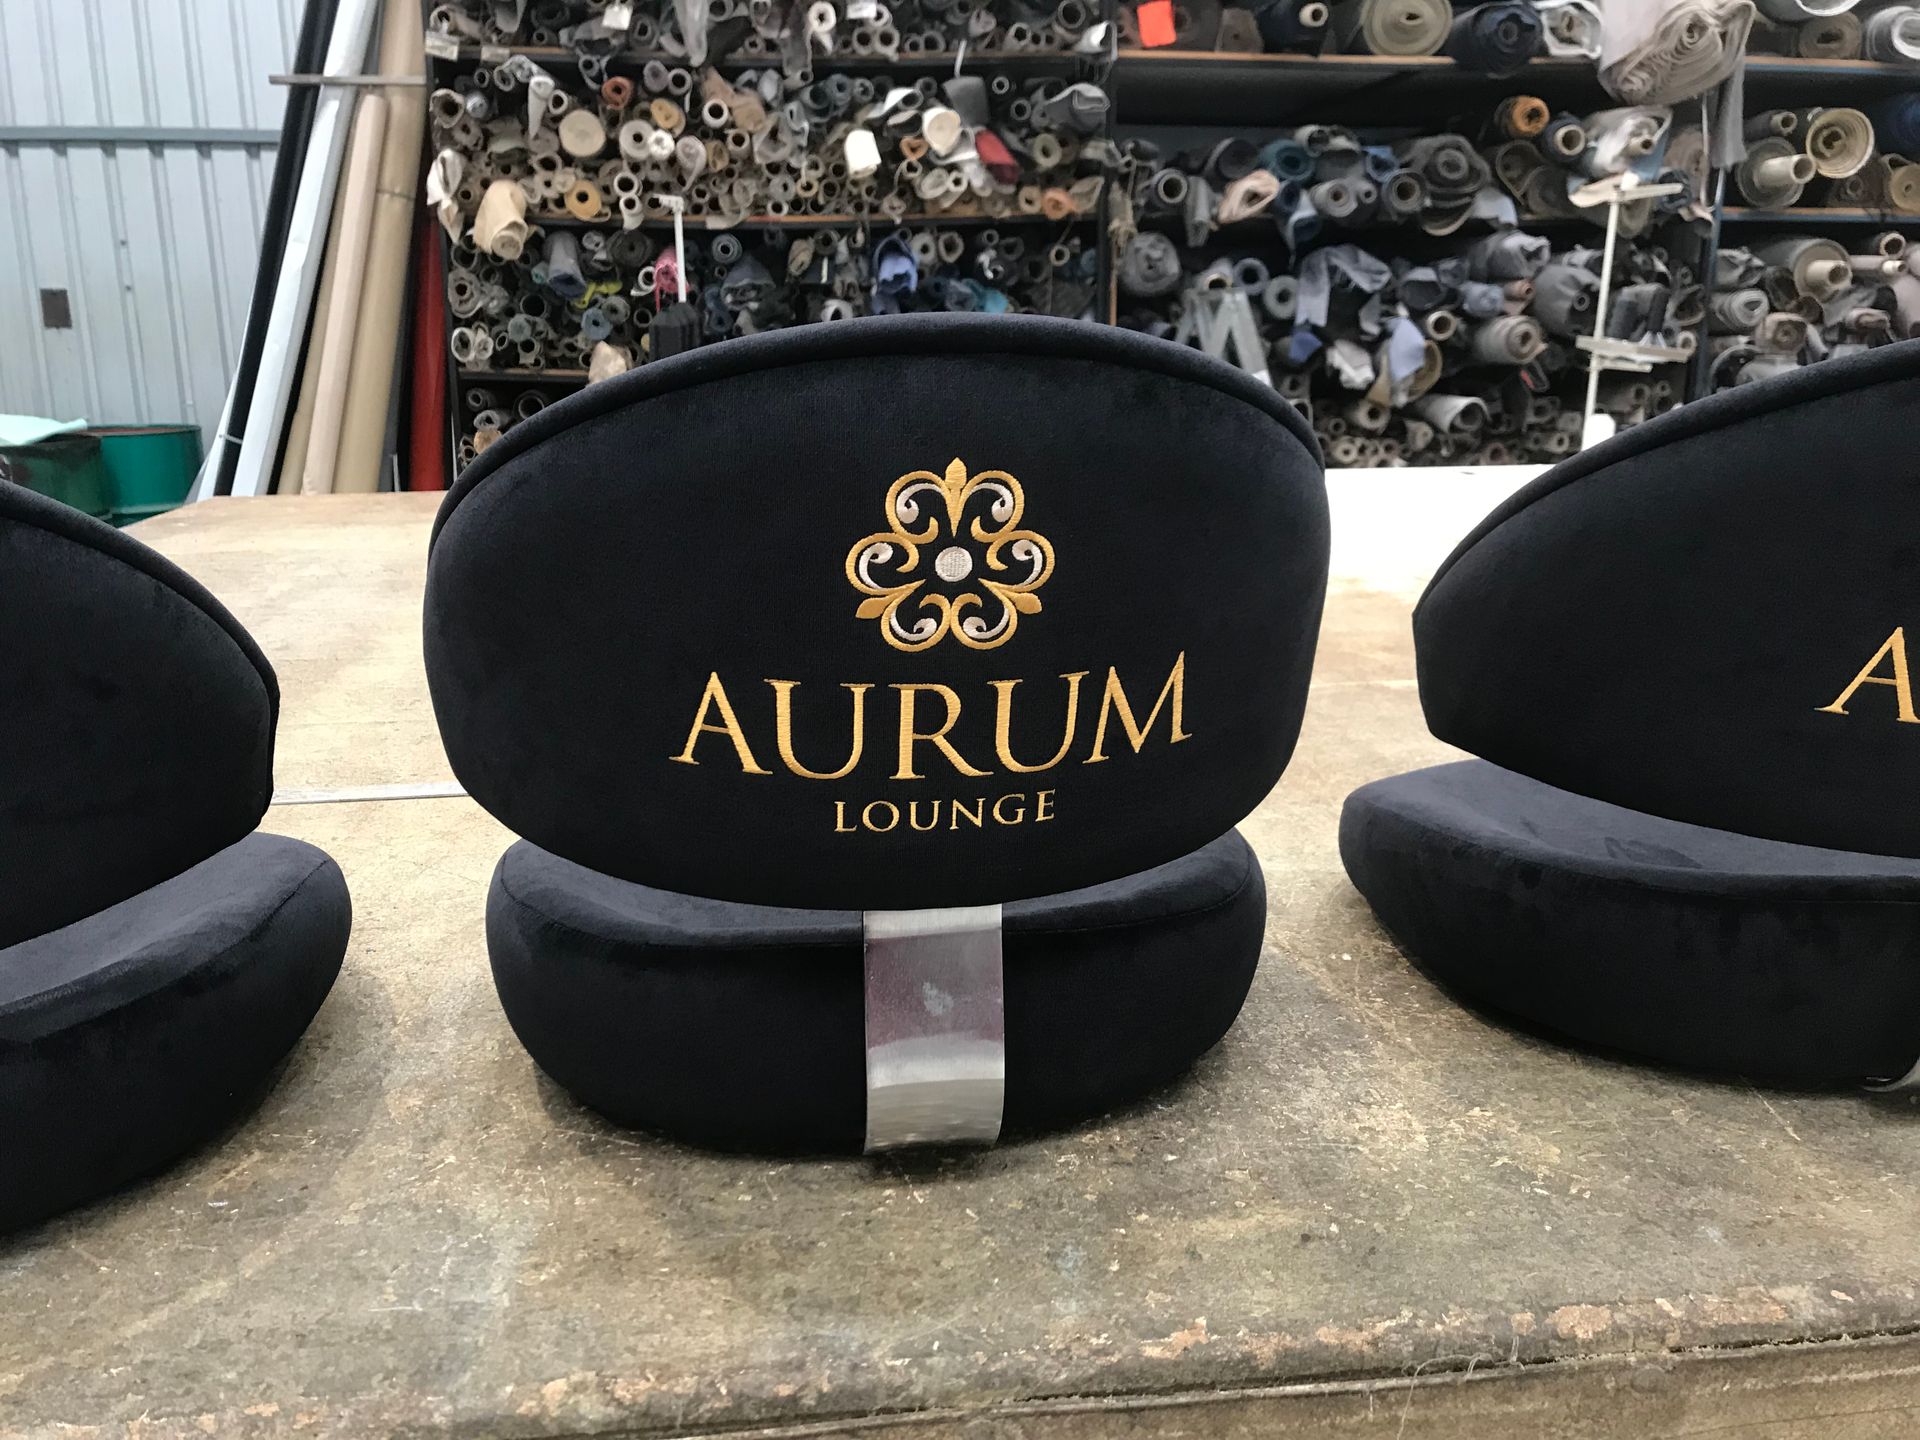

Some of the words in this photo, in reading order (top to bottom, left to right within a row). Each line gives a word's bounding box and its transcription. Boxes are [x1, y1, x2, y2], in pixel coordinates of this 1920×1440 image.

[668, 650, 1193, 780] AURUM
[1813, 626, 1920, 724] A
[834, 788, 1056, 833] LOUNGE
